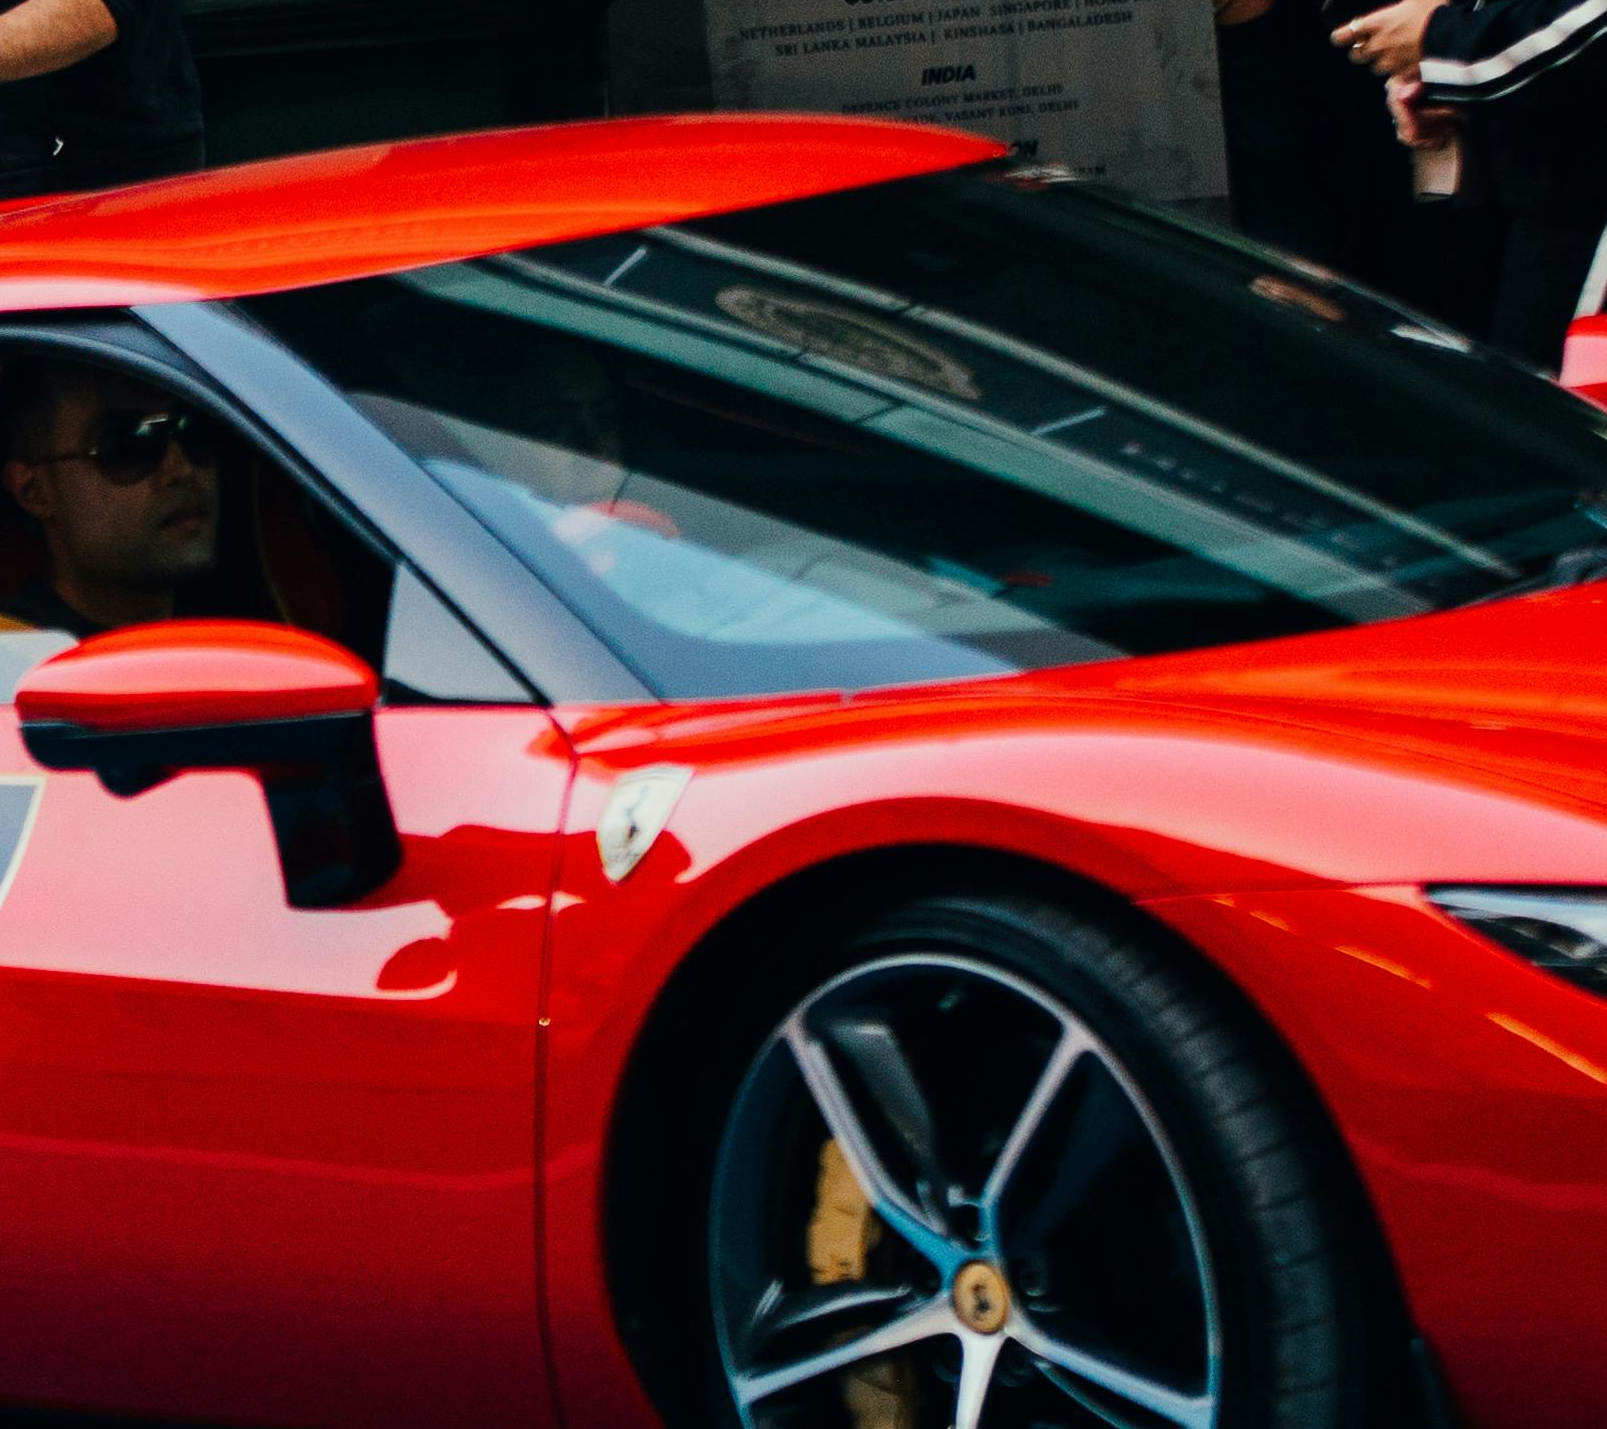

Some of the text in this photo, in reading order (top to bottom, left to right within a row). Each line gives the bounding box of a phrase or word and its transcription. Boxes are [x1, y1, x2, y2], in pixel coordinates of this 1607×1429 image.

[740, 21, 846, 41] NETHERLANDS
[858, 12, 924, 28] BELGIUM
[938, 6, 981, 22] JAPAN
[775, 42, 798, 58] SRI
[803, 38, 851, 55] LANKA
[855, 32, 927, 50] MALAYSIA
[944, 22, 1015, 40] KINSHASA
[921, 64, 976, 86] INDIA
[905, 93, 958, 109] COLONY
[1022, 83, 1064, 98] DELHI
[945, 106, 994, 121] VASANT
[1038, 98, 1079, 114] DELHI
